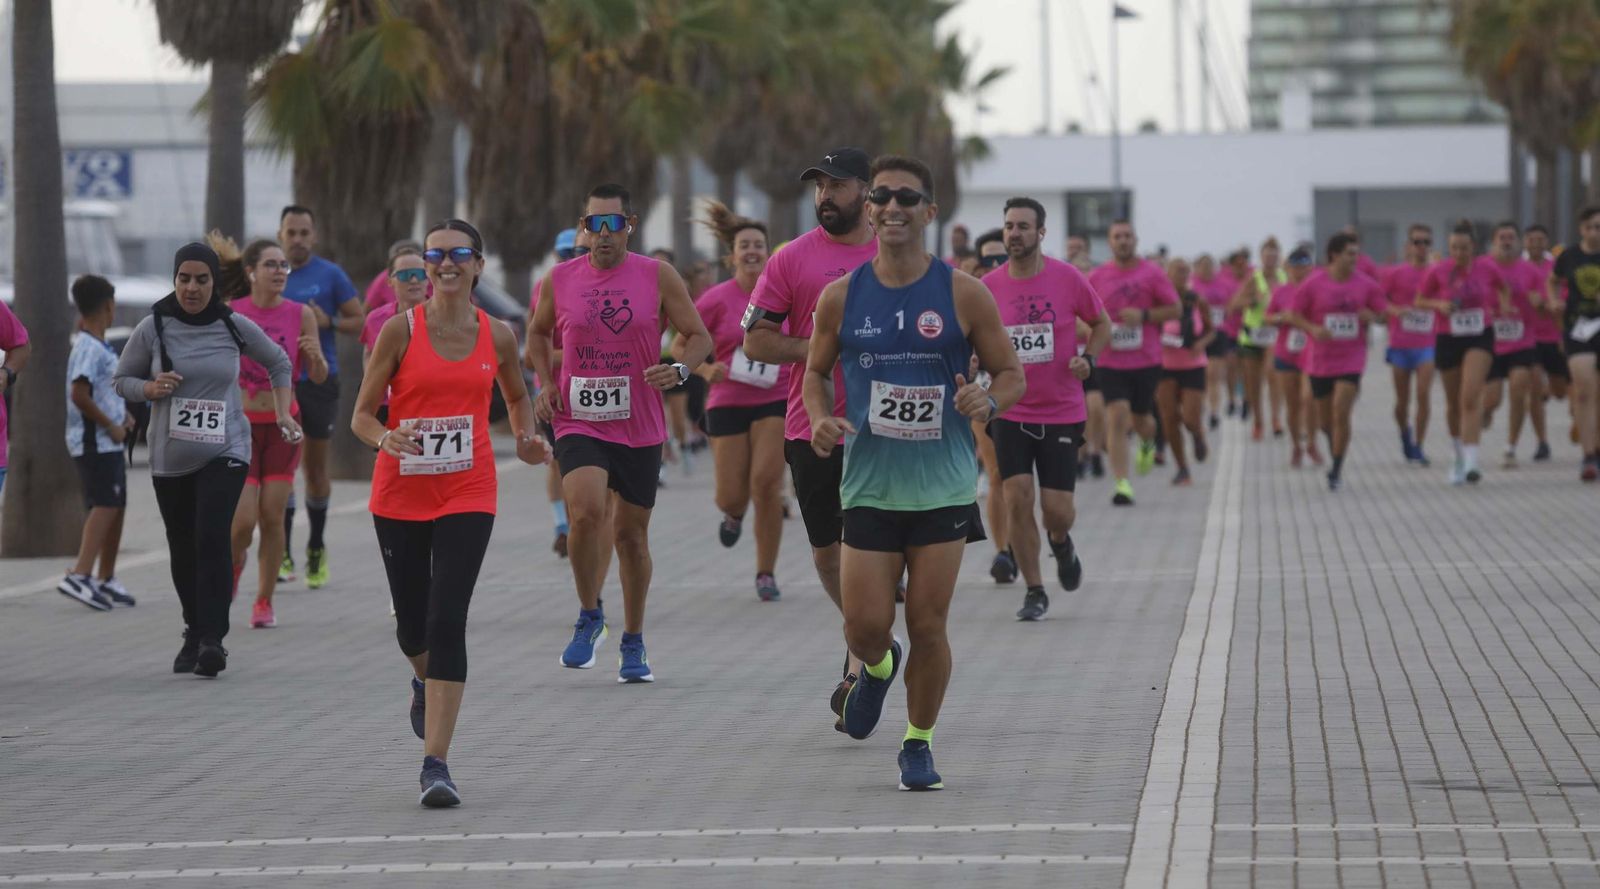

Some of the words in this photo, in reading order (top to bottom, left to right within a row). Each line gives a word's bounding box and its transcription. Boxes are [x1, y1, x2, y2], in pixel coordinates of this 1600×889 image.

[896, 309, 905, 330] 1
[854, 327, 882, 336] STRAITS
[576, 346, 594, 360] VIII
[874, 352, 906, 361] Transact
[906, 351, 942, 361] Payments
[579, 388, 621, 407] 891
[177, 410, 219, 429] 215
[879, 398, 935, 423] 282
